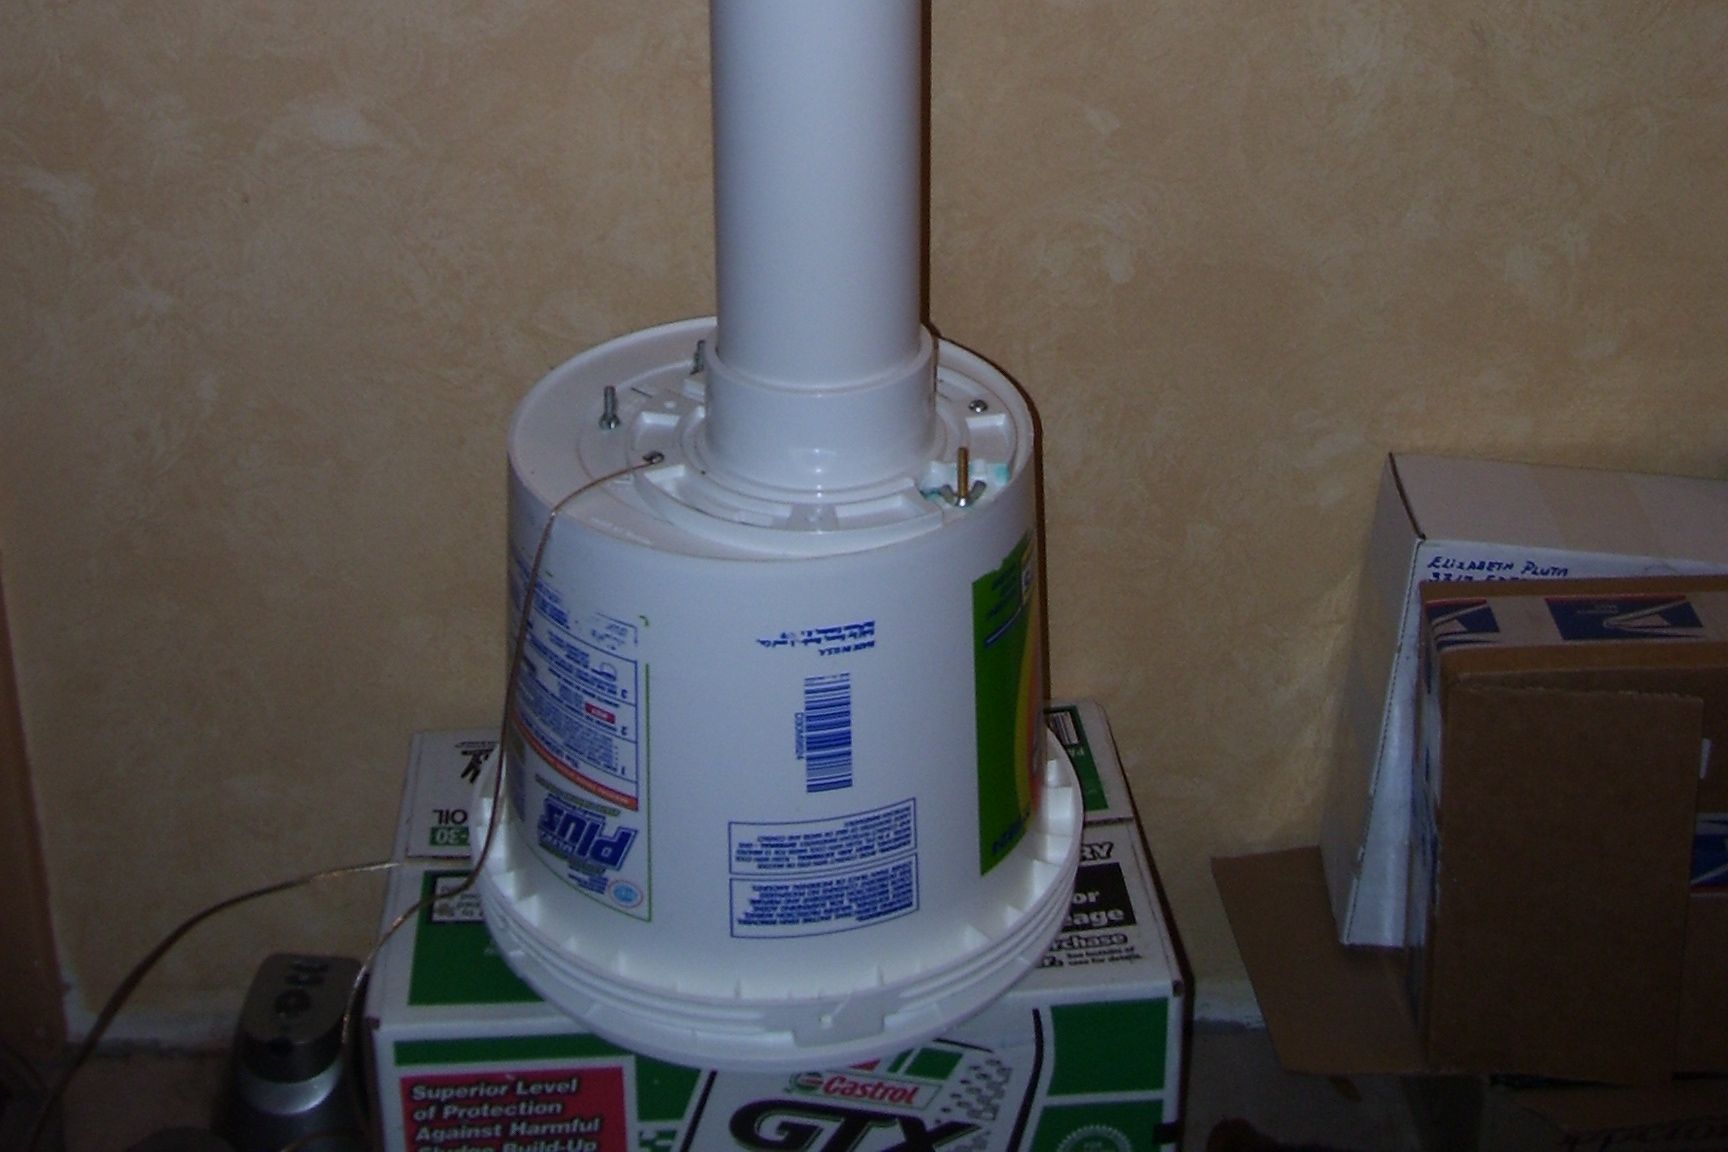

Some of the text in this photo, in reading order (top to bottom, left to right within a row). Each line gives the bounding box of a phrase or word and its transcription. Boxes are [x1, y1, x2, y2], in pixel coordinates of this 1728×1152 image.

[411, 1077, 579, 1102] Superior Level
[822, 1073, 919, 1105] Castrol
[413, 1101, 563, 1122] of Protection
[415, 1117, 601, 1143] Against Harmful
